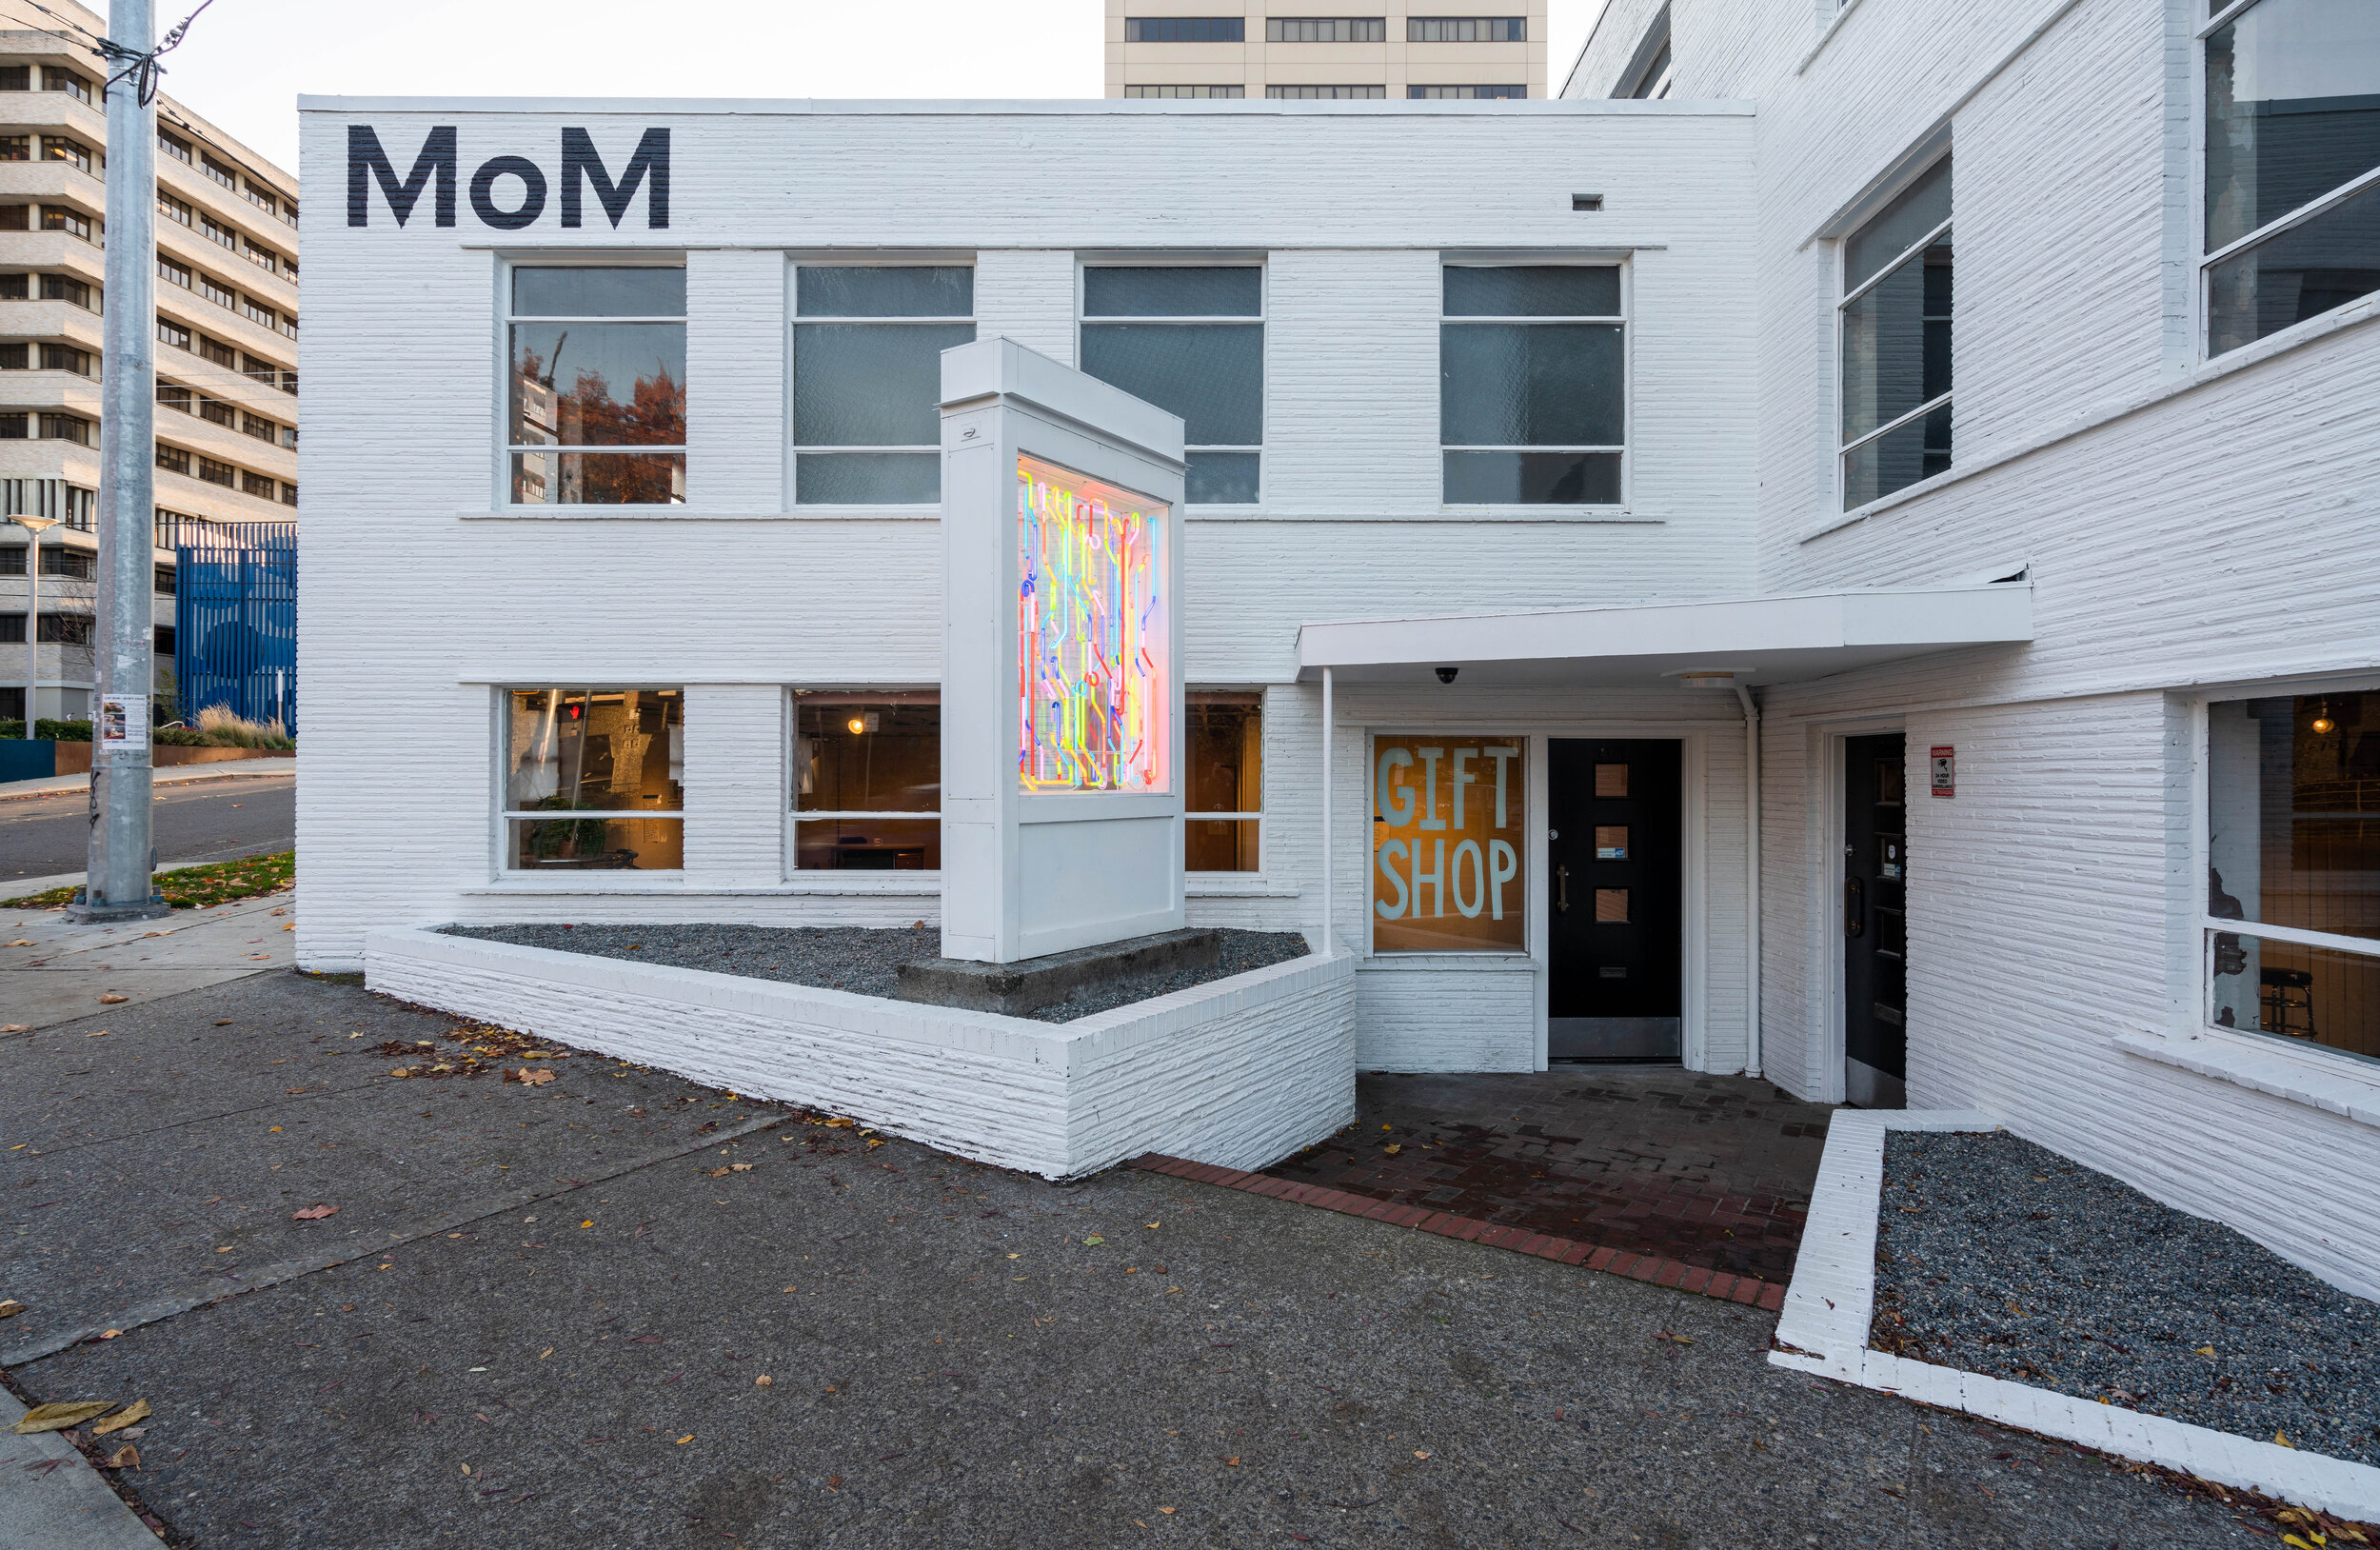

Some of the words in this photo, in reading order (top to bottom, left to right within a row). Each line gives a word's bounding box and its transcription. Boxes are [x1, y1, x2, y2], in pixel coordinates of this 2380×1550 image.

[347, 125, 670, 230] MoM
[1377, 746, 1519, 830] GIFT
[1375, 838, 1517, 921] SHOP
